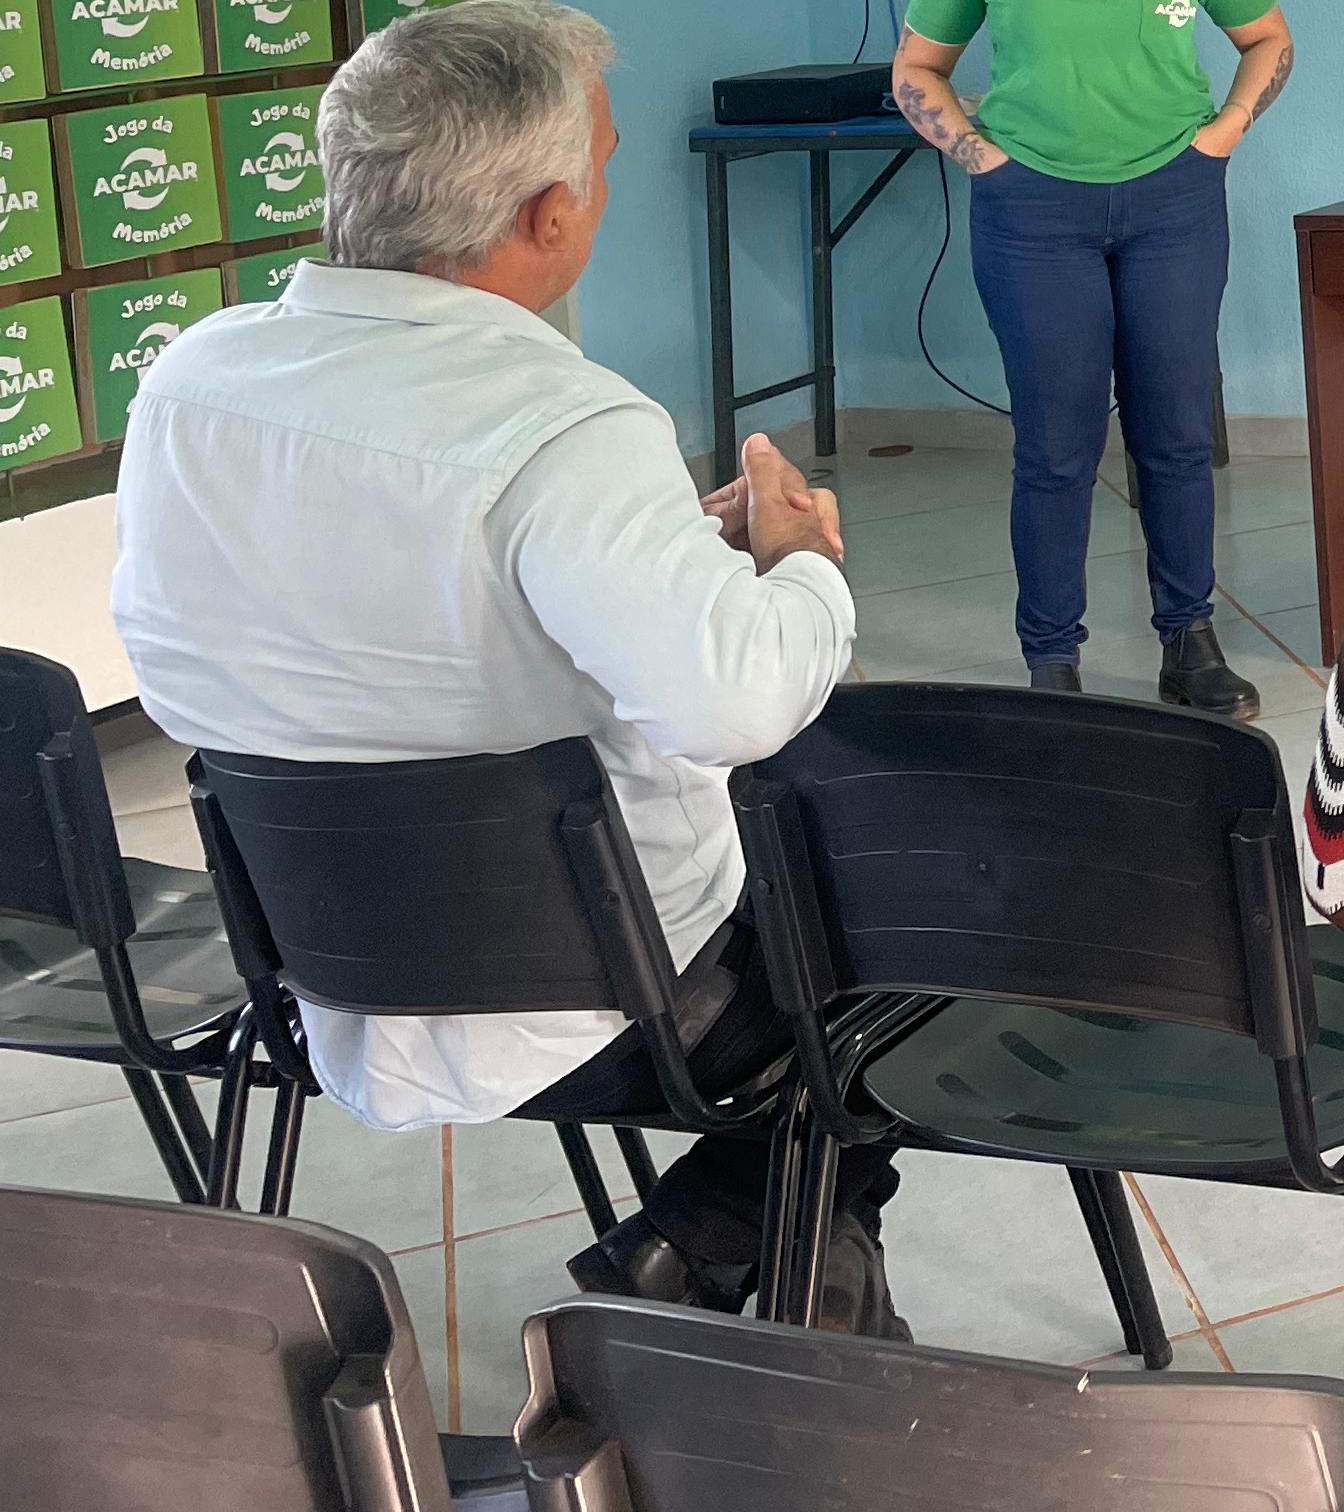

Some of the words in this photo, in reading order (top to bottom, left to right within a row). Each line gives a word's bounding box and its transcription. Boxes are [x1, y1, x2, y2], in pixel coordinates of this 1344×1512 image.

[91, 44, 172, 70] Memória
[250, 105, 288, 126] Jogo
[292, 103, 310, 119] da
[104, 119, 147, 143] Jogo
[152, 116, 173, 133] da
[240, 150, 319, 176] ACAMA
[94, 161, 197, 197] ACAMAR
[112, 213, 192, 242] Memória
[268, 262, 297, 287] Jog
[121, 293, 163, 318] Jogo
[167, 290, 187, 308] da
[5, 322, 27, 340] da
[109, 344, 165, 372] ACA
[0, 368, 54, 398] MAR
[0, 423, 51, 456] mória
